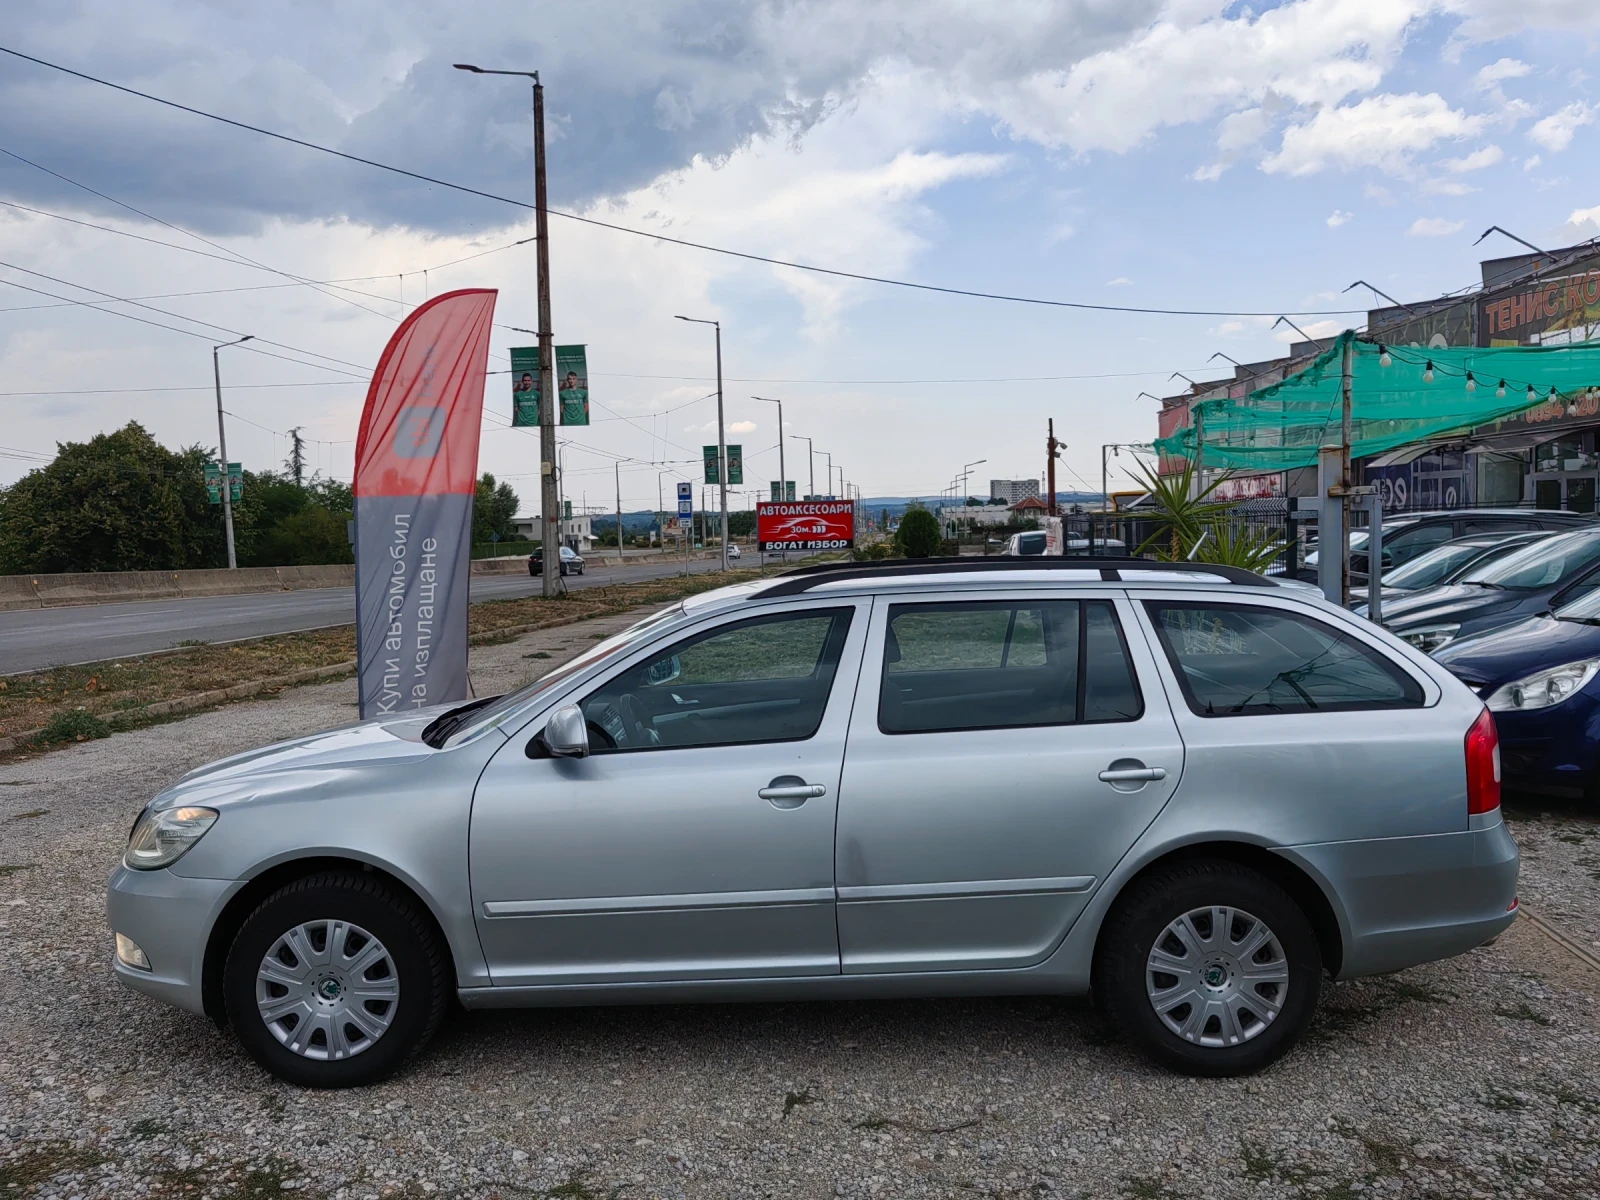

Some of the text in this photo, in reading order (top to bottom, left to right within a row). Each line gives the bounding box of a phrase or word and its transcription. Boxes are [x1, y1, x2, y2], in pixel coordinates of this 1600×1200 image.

[1486, 282, 1560, 334] ТЕНИС
[760, 504, 852, 516] АВТОАКСЕСОАРИ
[766, 540, 848, 550] БОГАТ ИЗБОР
[376, 514, 411, 716] Купи автомобил
[414, 537, 438, 678] изплащане
